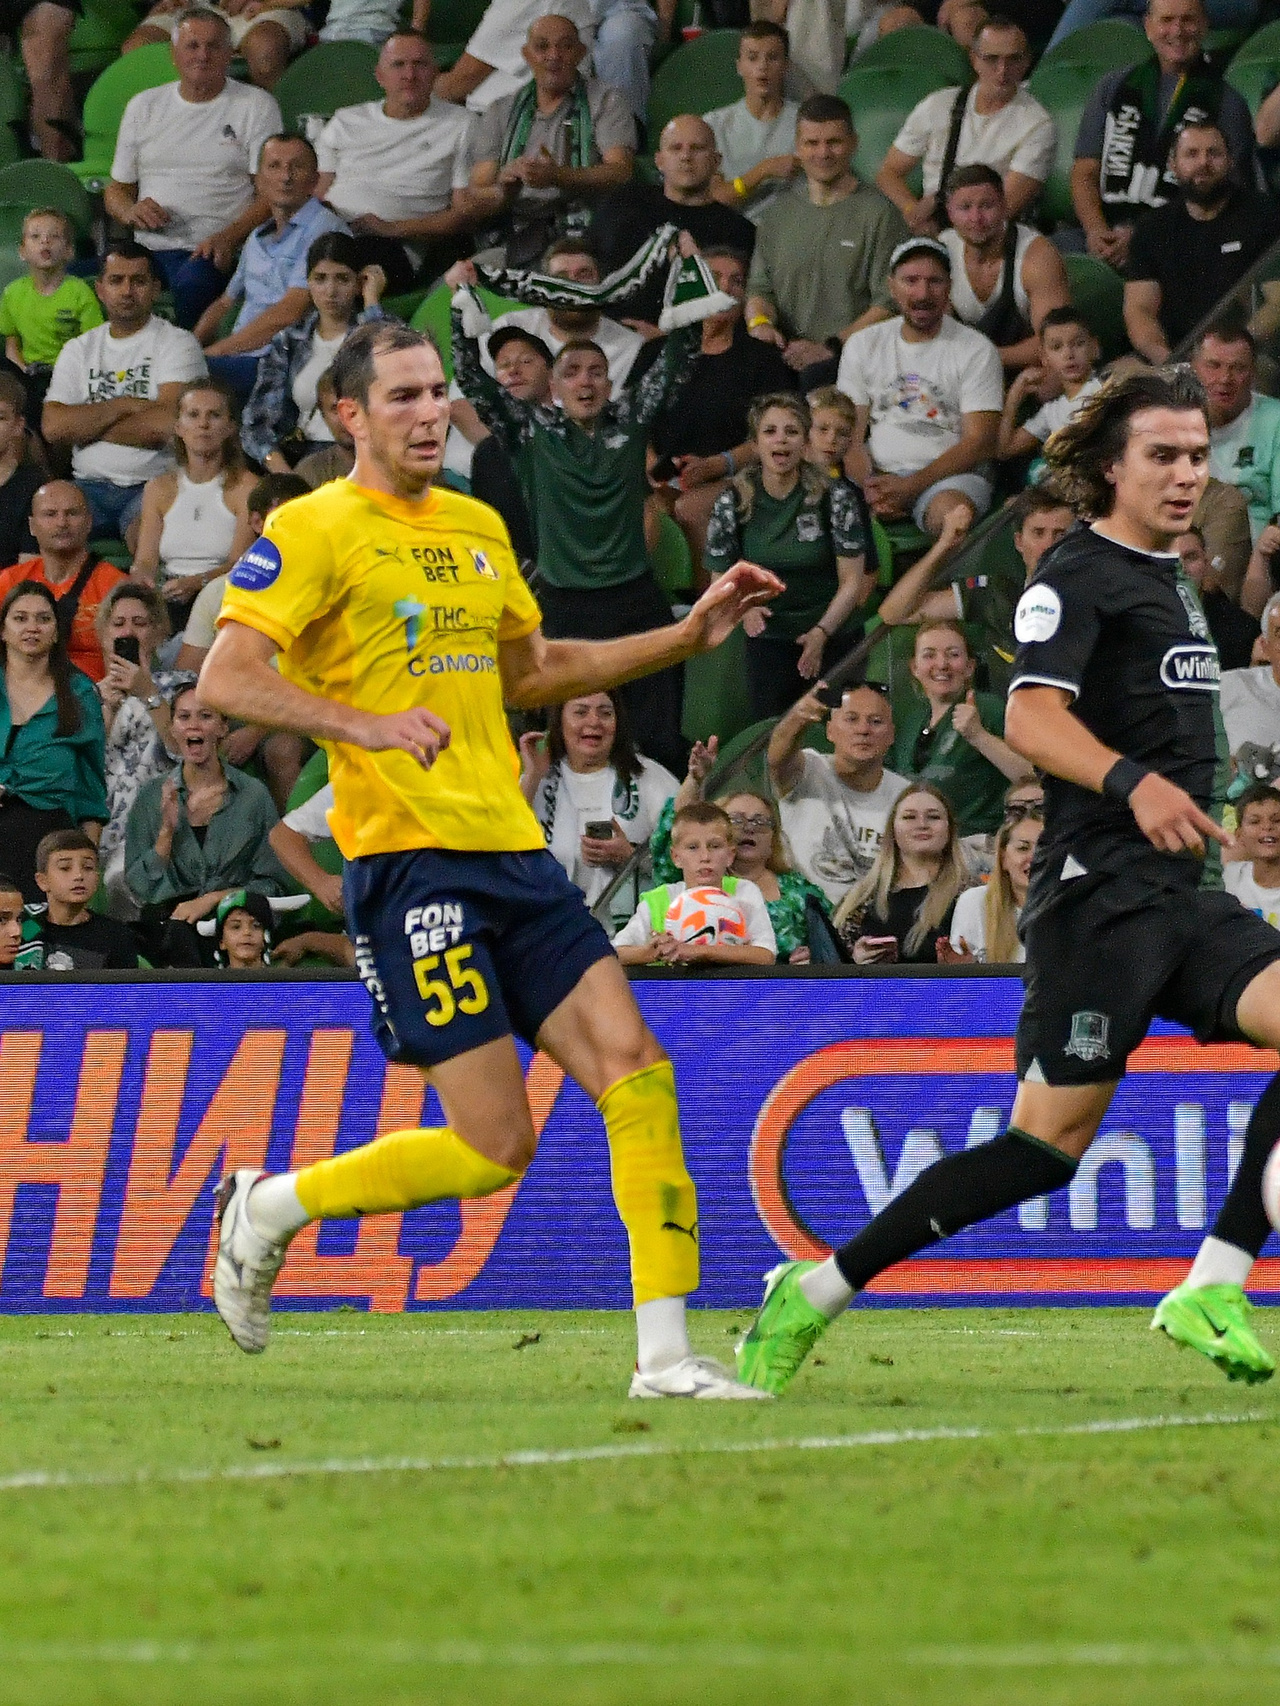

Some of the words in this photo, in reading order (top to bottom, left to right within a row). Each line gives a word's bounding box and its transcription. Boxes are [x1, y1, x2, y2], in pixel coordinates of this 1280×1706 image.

[411, 547, 455, 564] FON
[422, 565, 460, 583] BET
[404, 902, 464, 935] FON
[410, 926, 463, 959] BET
[412, 943, 490, 1027] 55
